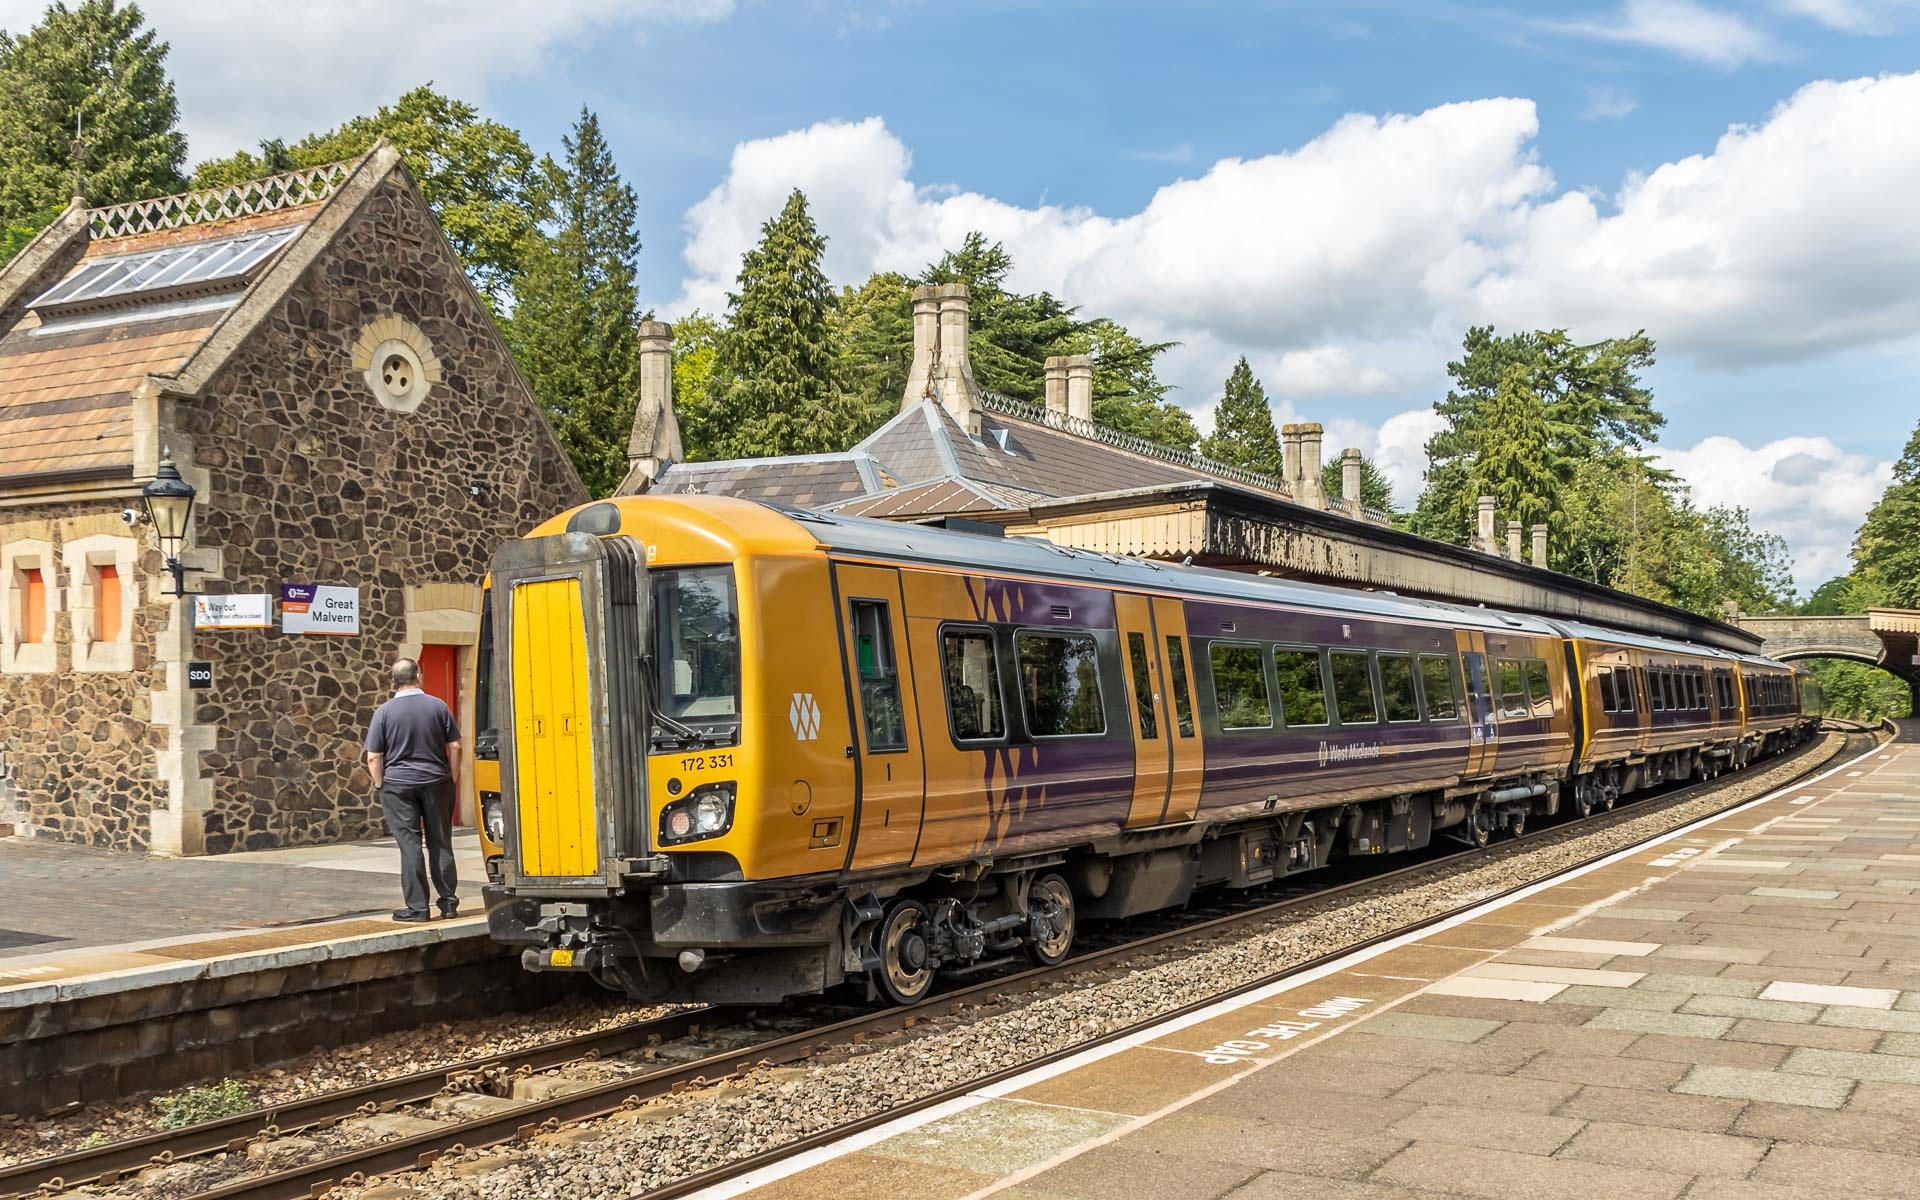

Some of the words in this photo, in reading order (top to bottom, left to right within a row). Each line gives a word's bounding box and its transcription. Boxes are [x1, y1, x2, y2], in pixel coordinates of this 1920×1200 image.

[208, 602, 223, 613] Way
[224, 603, 236, 612] out
[325, 598, 354, 610] Great
[312, 611, 354, 623] Malvern
[189, 670, 211, 681] SDO
[1329, 744, 1348, 762] West
[1349, 741, 1380, 761] Midlands
[681, 757, 705, 772] 172
[709, 754, 734, 769] 331
[1297, 996, 1374, 1019] MIND
[1245, 1020, 1323, 1040] THE
[1199, 1040, 1270, 1064] GAP
